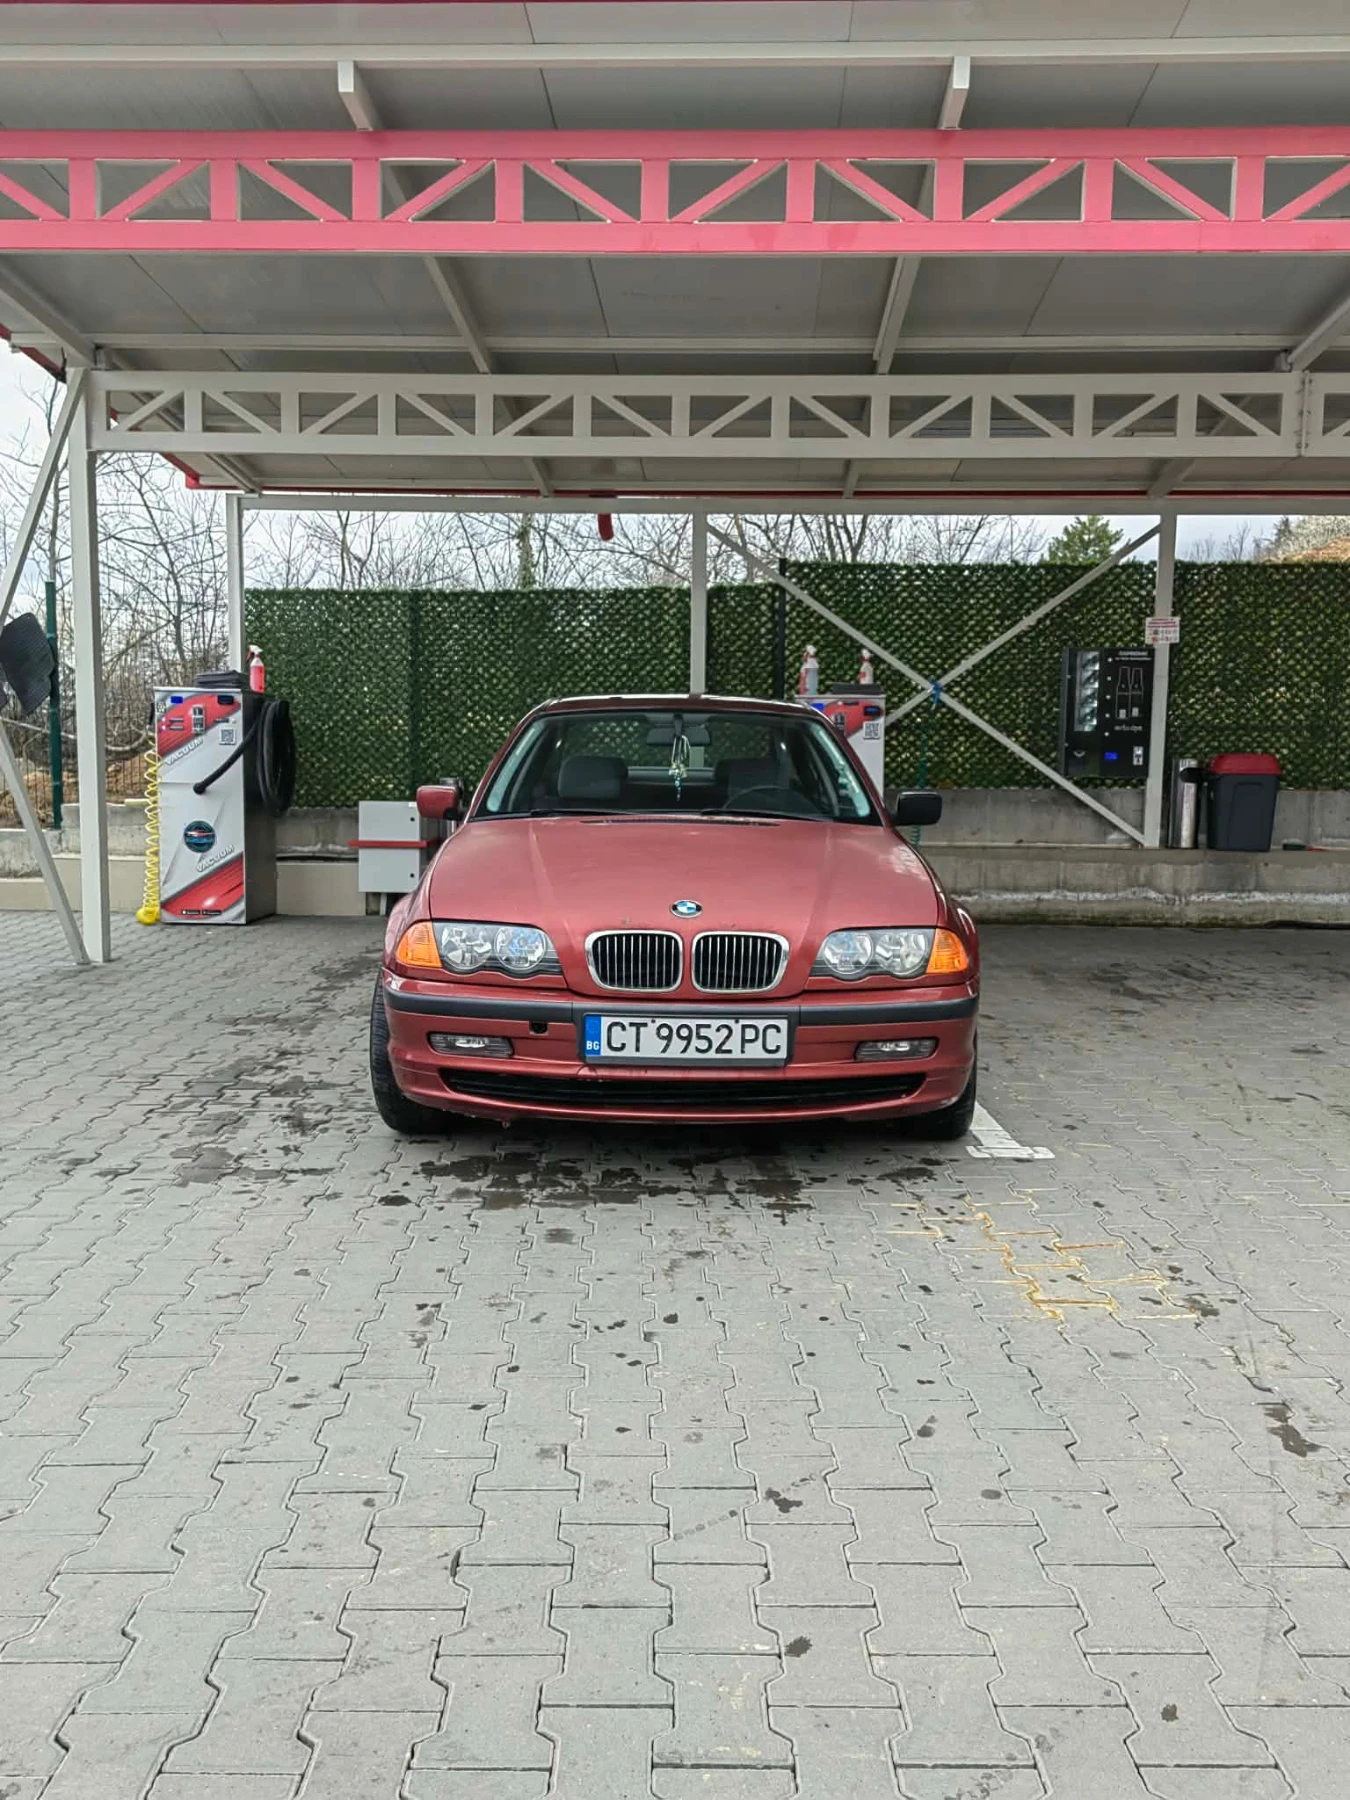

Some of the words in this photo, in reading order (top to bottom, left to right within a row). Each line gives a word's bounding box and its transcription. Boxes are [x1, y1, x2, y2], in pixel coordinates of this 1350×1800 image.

[165, 738, 204, 766] VACUUM
[196, 844, 235, 872] VACUUM
[586, 1040, 600, 1050] BG
[606, 1021, 648, 1052] CT
[655, 1023, 734, 1054] 9952
[740, 1024, 782, 1055] PC
